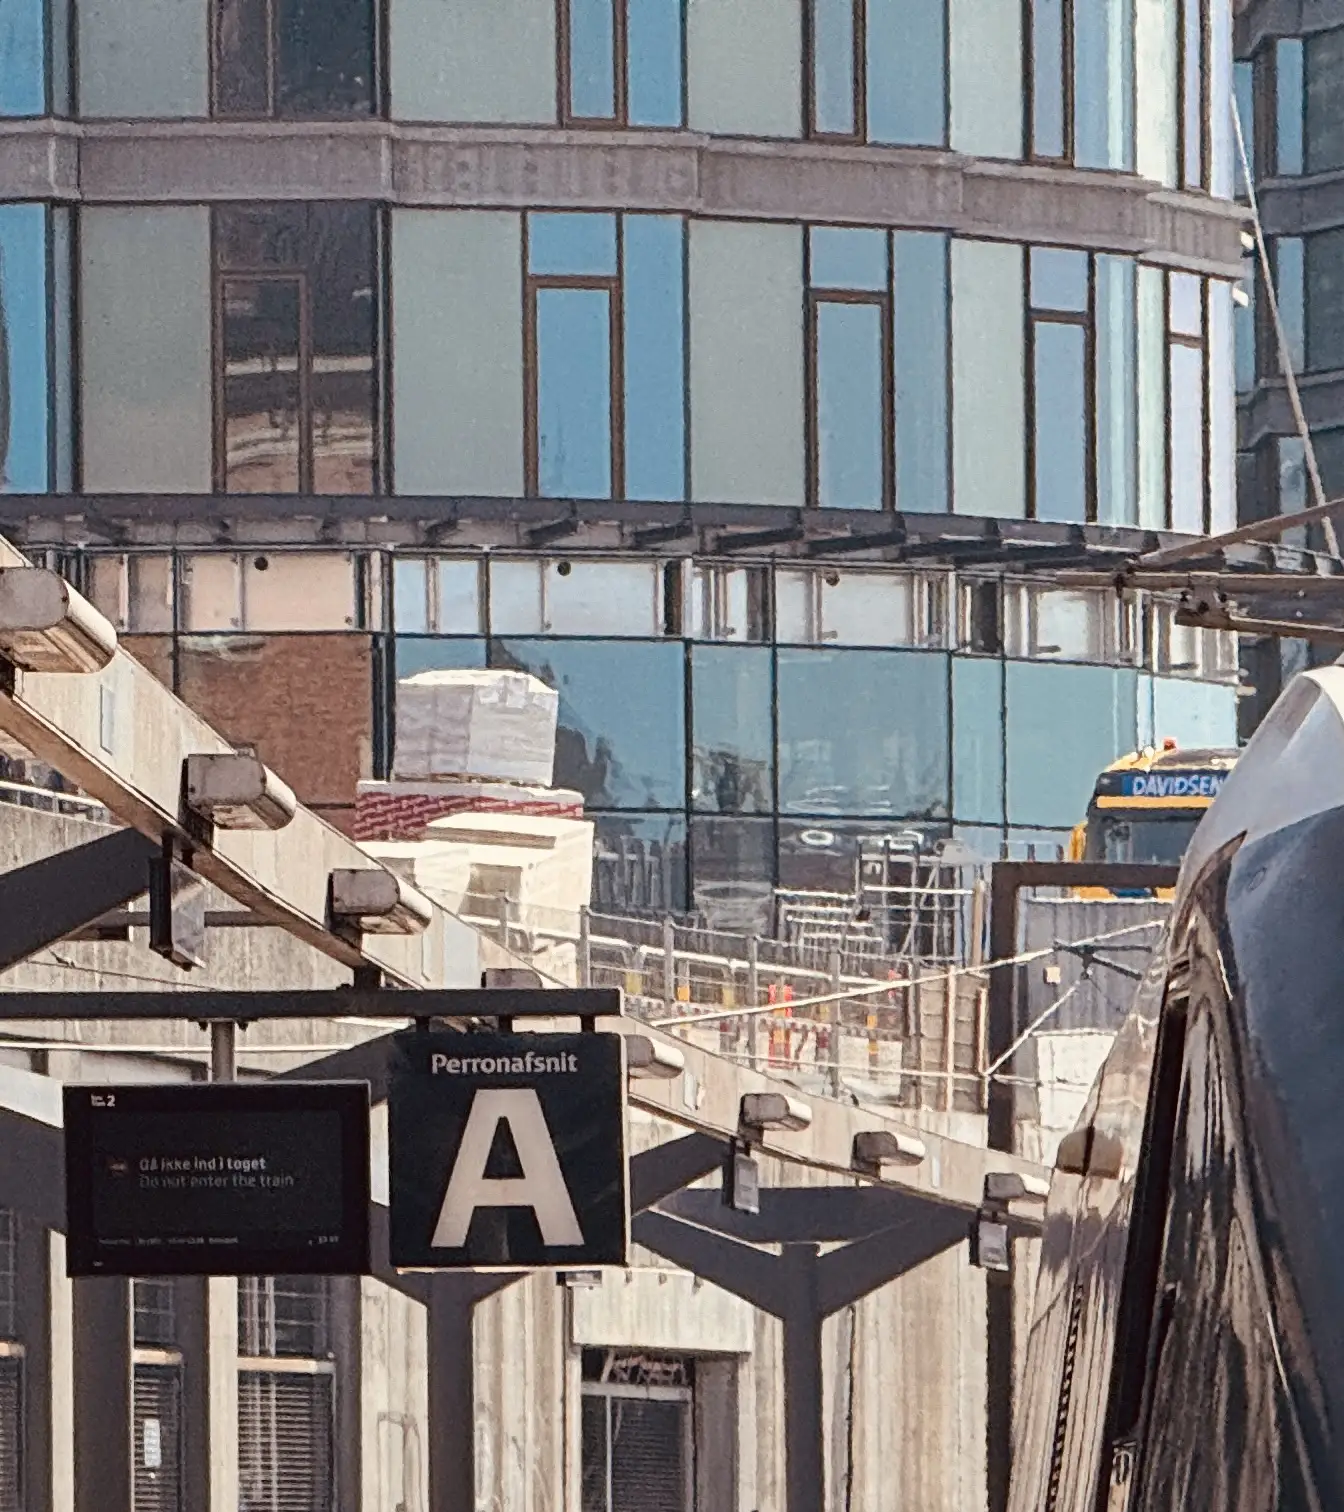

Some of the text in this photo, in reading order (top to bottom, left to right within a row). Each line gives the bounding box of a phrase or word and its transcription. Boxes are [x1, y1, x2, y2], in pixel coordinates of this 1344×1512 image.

[431, 1051, 578, 1075] Perronafsnit
[107, 1093, 116, 1107] 2
[227, 1155, 266, 1172] toget
[430, 1087, 586, 1249] A
[232, 1172, 256, 1187] the
[259, 1170, 295, 1187] train
